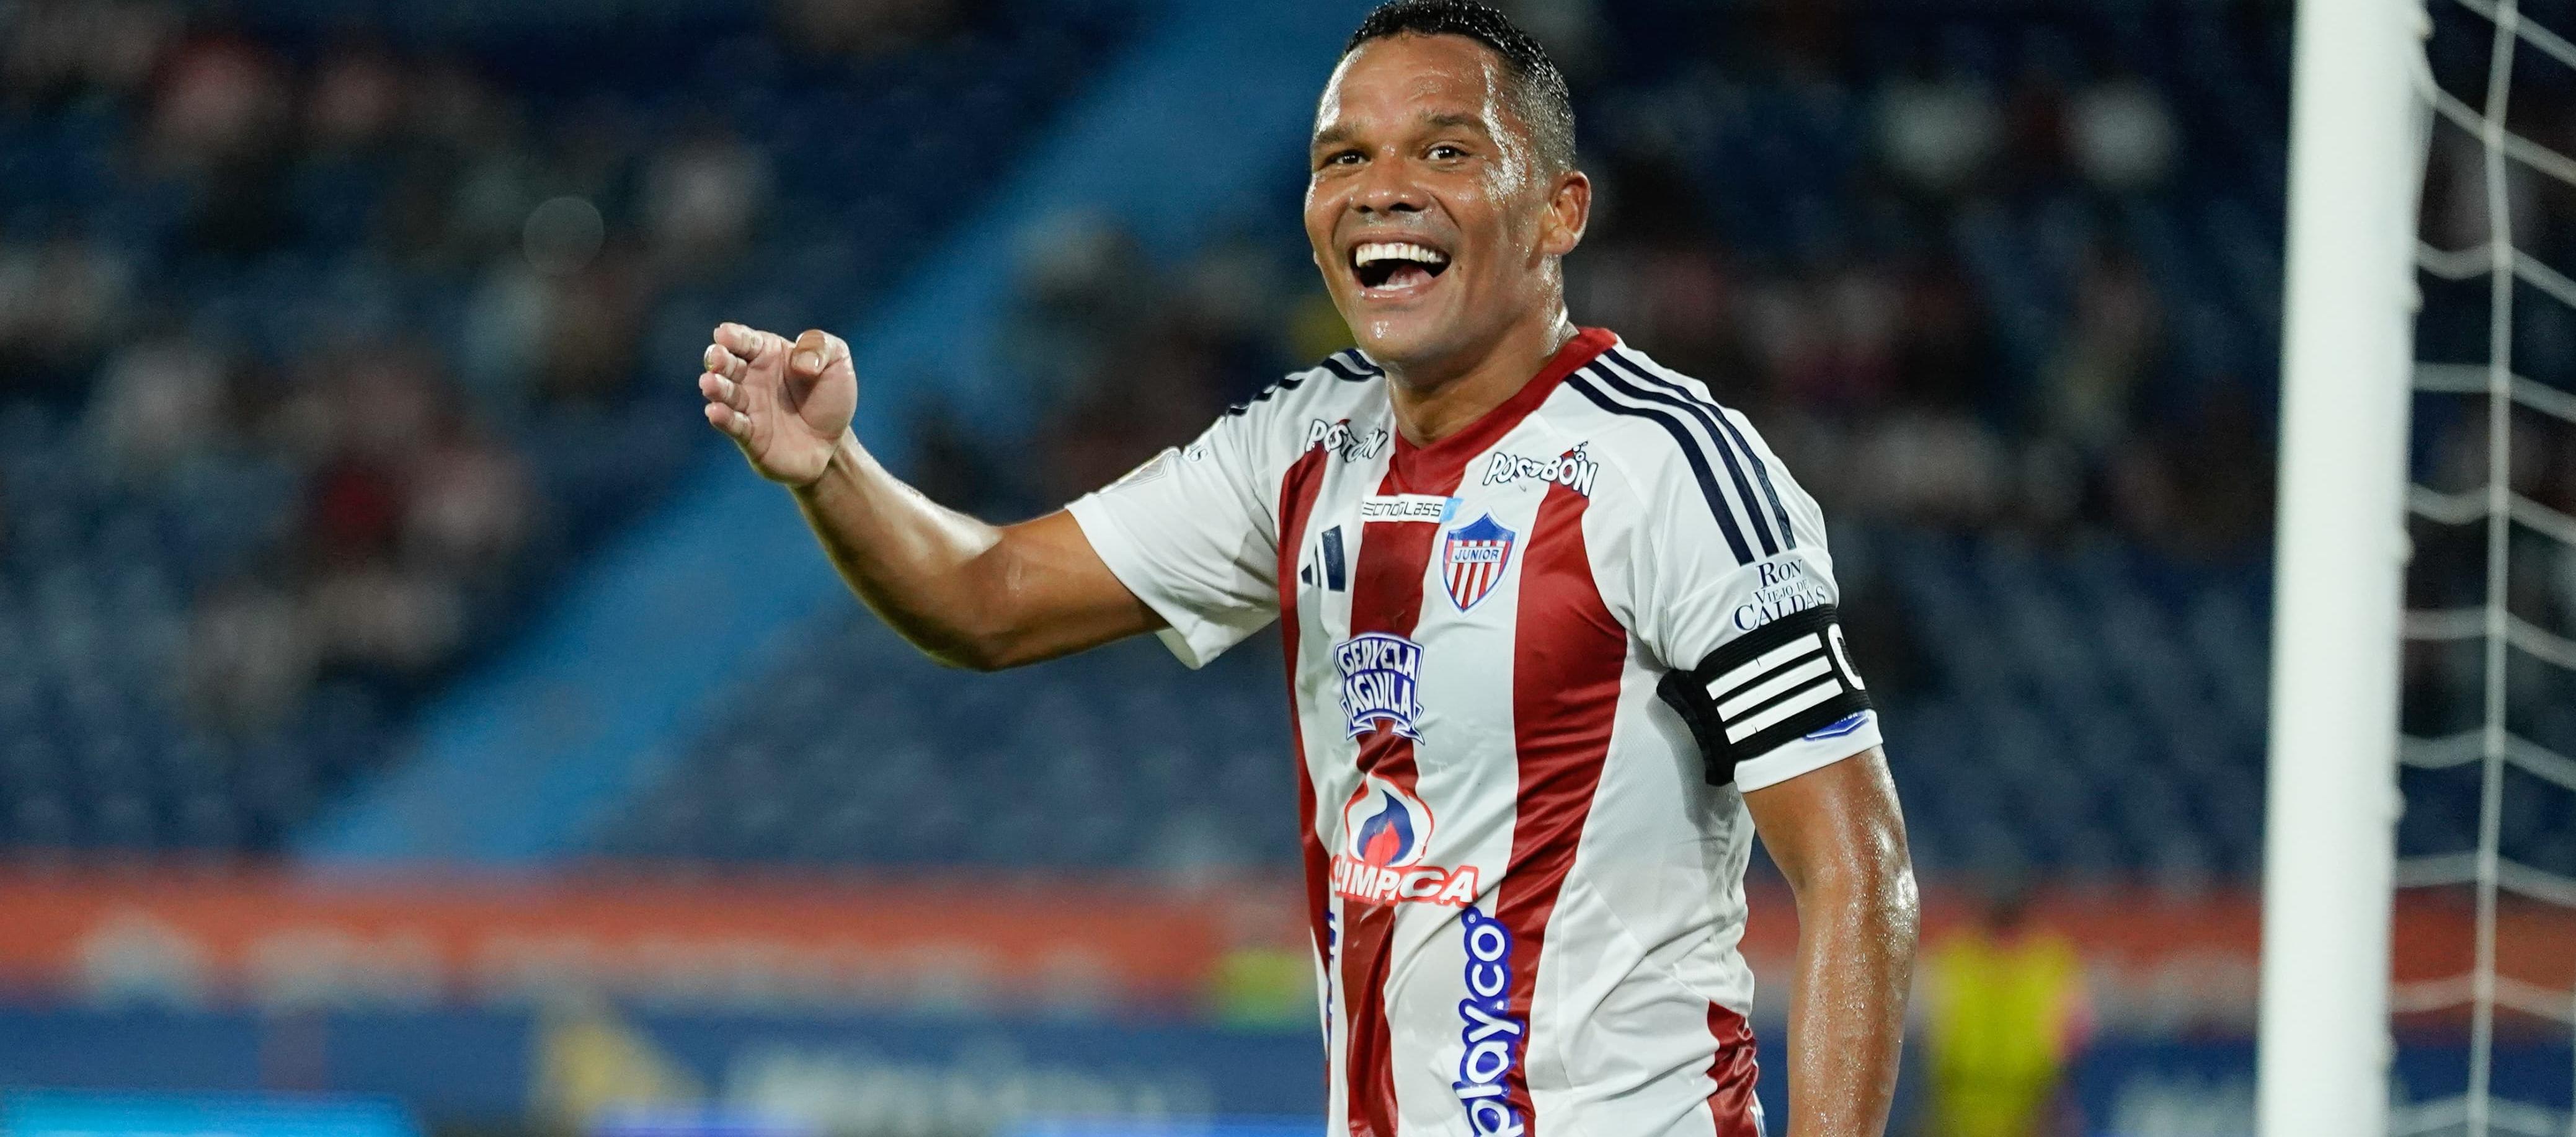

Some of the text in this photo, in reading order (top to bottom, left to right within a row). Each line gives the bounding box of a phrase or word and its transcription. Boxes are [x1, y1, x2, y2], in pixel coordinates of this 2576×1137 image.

[1455, 549, 1499, 560] JUNIOR
[1757, 559, 1802, 589] RON
[1754, 579, 1810, 604] VIEJO DE
[1734, 585, 1826, 630] CALDAS
